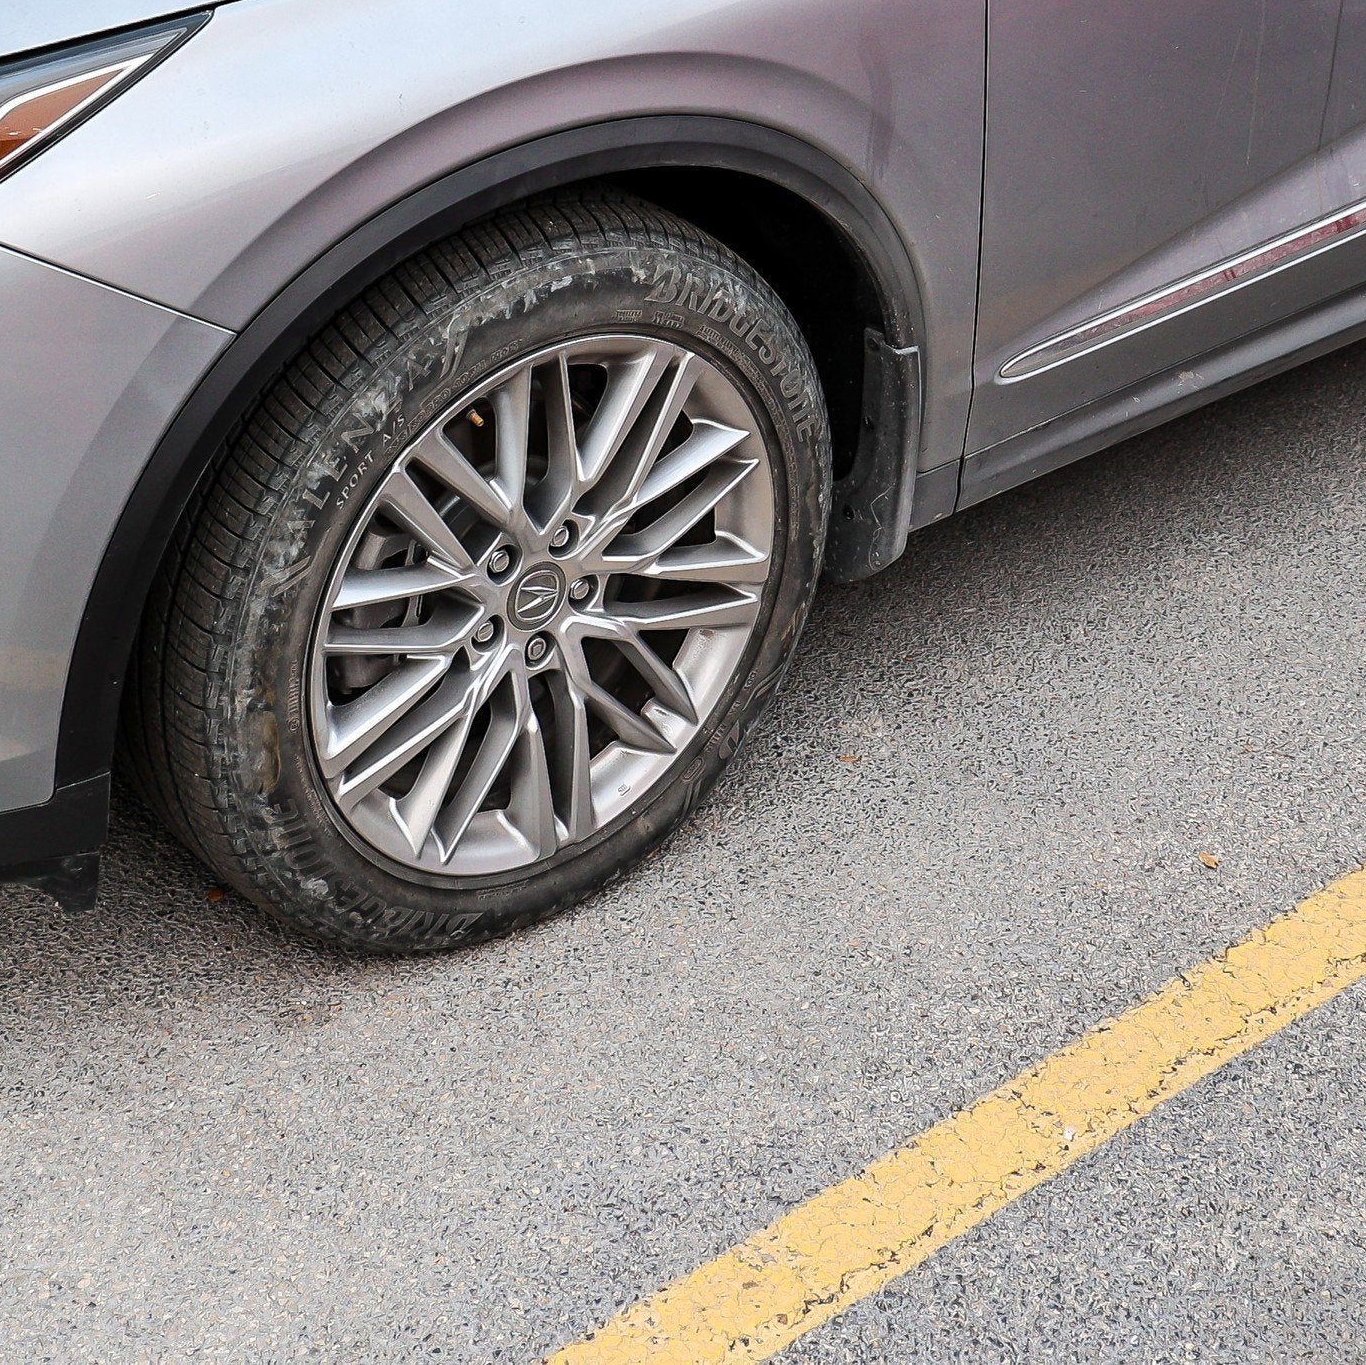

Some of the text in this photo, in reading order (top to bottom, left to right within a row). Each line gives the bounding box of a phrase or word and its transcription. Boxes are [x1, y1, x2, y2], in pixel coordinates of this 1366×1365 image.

[644, 264, 821, 443] BRIDGESTONE
[336, 413, 405, 510] SPORT A/S
